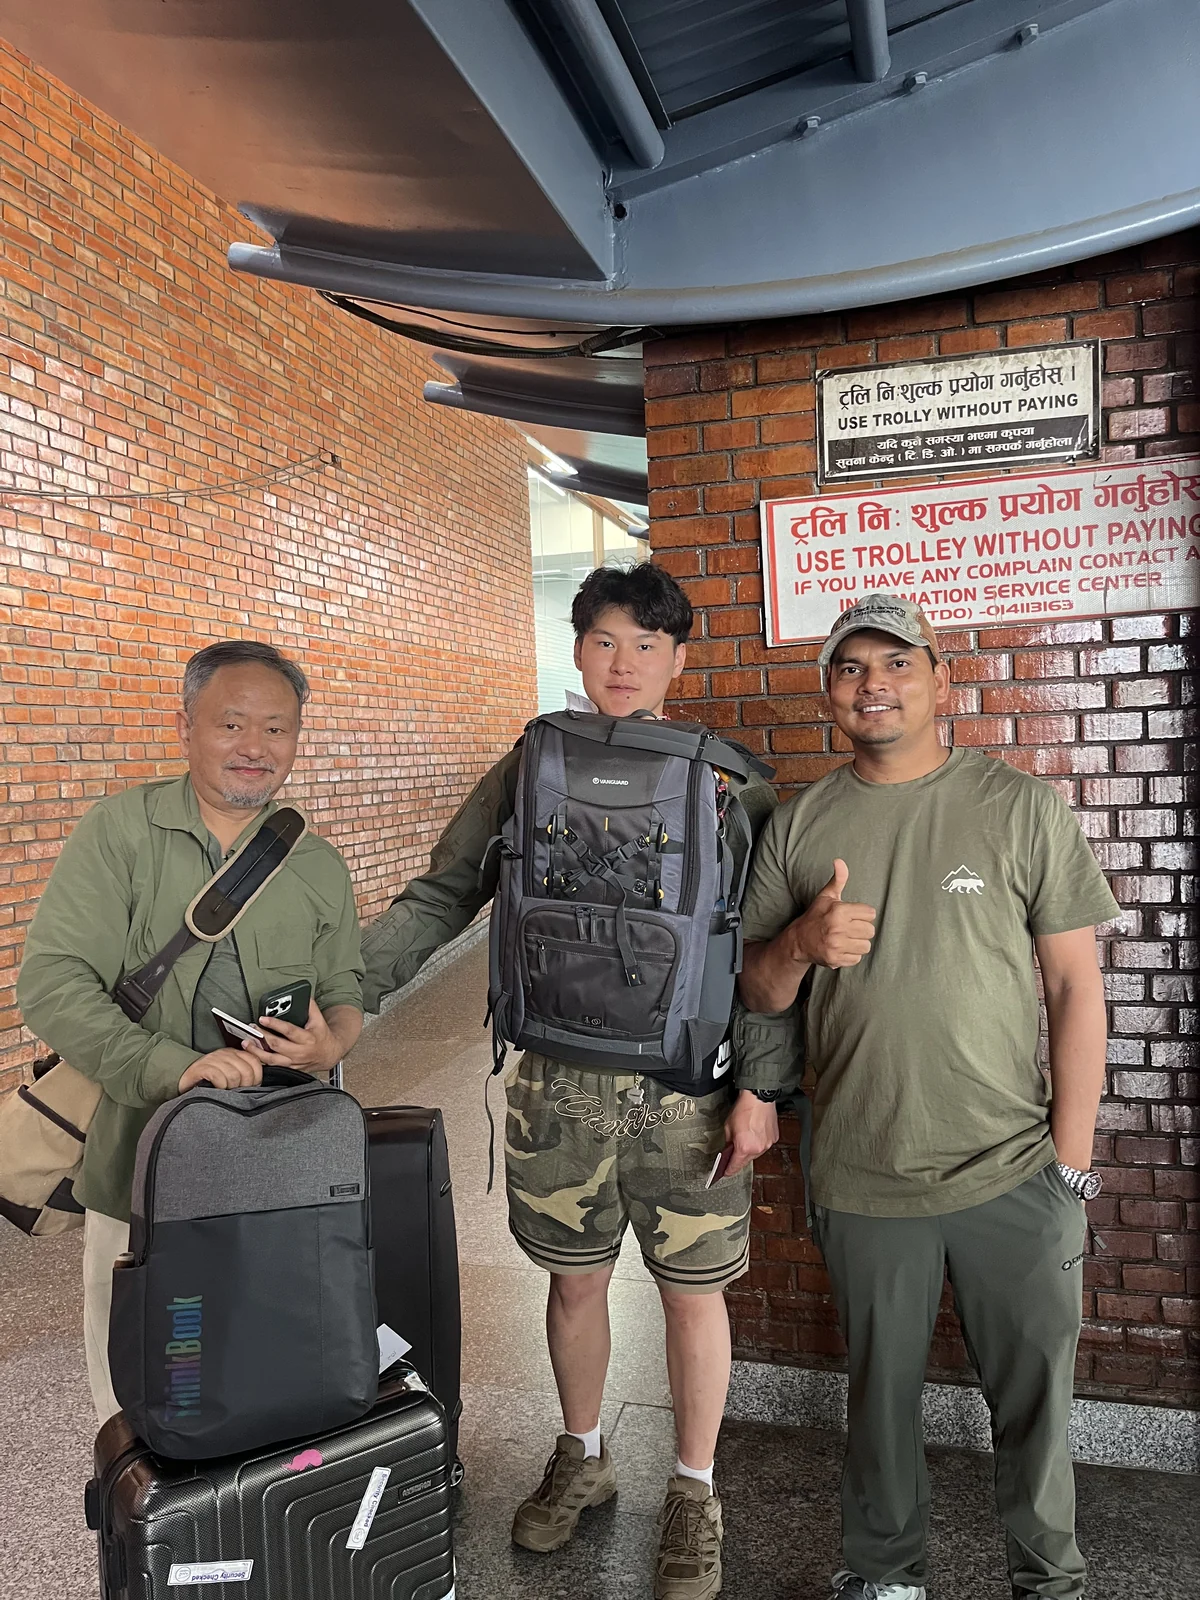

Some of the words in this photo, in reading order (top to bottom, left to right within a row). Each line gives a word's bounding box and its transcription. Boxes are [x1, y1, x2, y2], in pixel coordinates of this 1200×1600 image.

[949, 372, 995, 396] प्रयोग
[838, 415, 867, 430] USE
[873, 408, 932, 426] TROLLY
[937, 400, 1012, 420] WITHOUT
[1018, 393, 1078, 412] PAYING
[998, 484, 1083, 522] प्रयोग
[796, 548, 845, 574] USE
[852, 536, 967, 569] TROLLEY
[974, 525, 1099, 557] WITHOUT
[794, 580, 812, 596] IF
[817, 576, 856, 593] YOU
[863, 571, 915, 589] HAVE
[921, 566, 961, 584] ANY
[966, 557, 1072, 579] COMPLAIN
[1079, 547, 1179, 570] CONTACT
[839, 587, 977, 612] INMATION
[983, 579, 1070, 601] SERVICE
[1078, 572, 1163, 592] CENTER
[164, 1295, 203, 1421] ThinkBook
